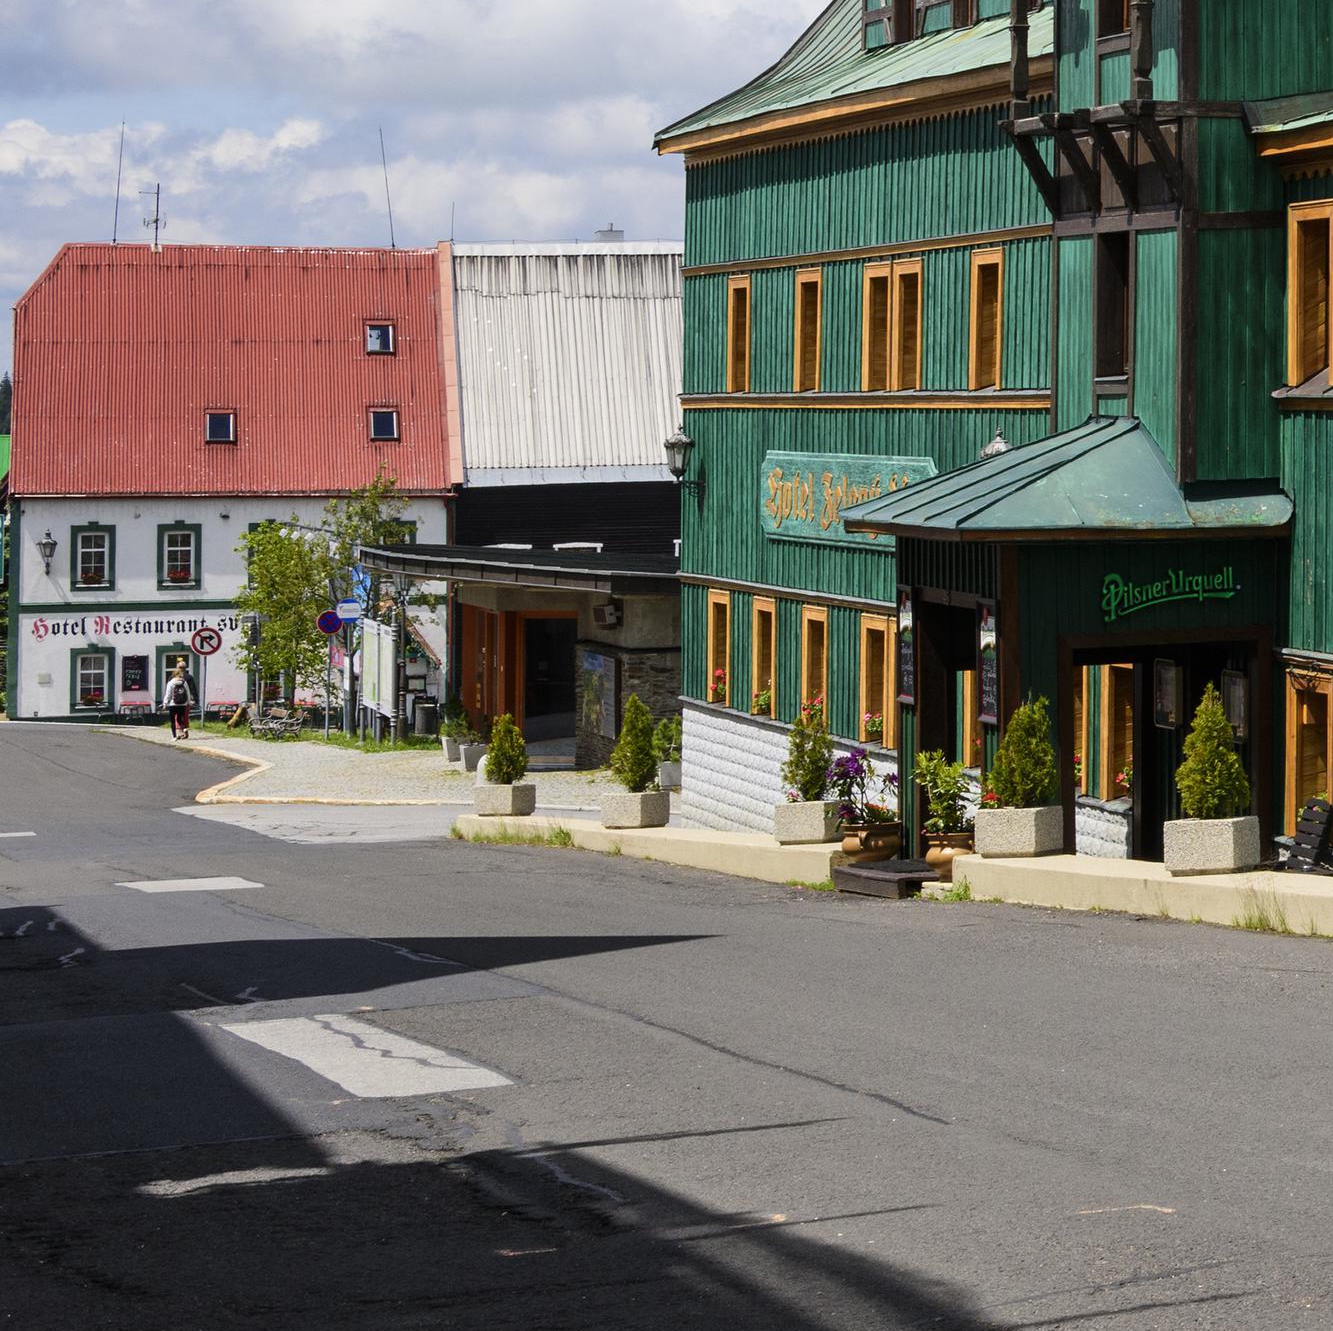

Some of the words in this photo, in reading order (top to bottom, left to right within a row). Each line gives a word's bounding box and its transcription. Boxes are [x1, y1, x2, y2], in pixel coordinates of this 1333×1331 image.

[766, 468, 815, 528] Hotel
[1102, 573, 1169, 622] Pilsner
[1168, 566, 1233, 601] Urquell
[32, 616, 86, 642] Hotel
[94, 615, 207, 636] Restaurant
